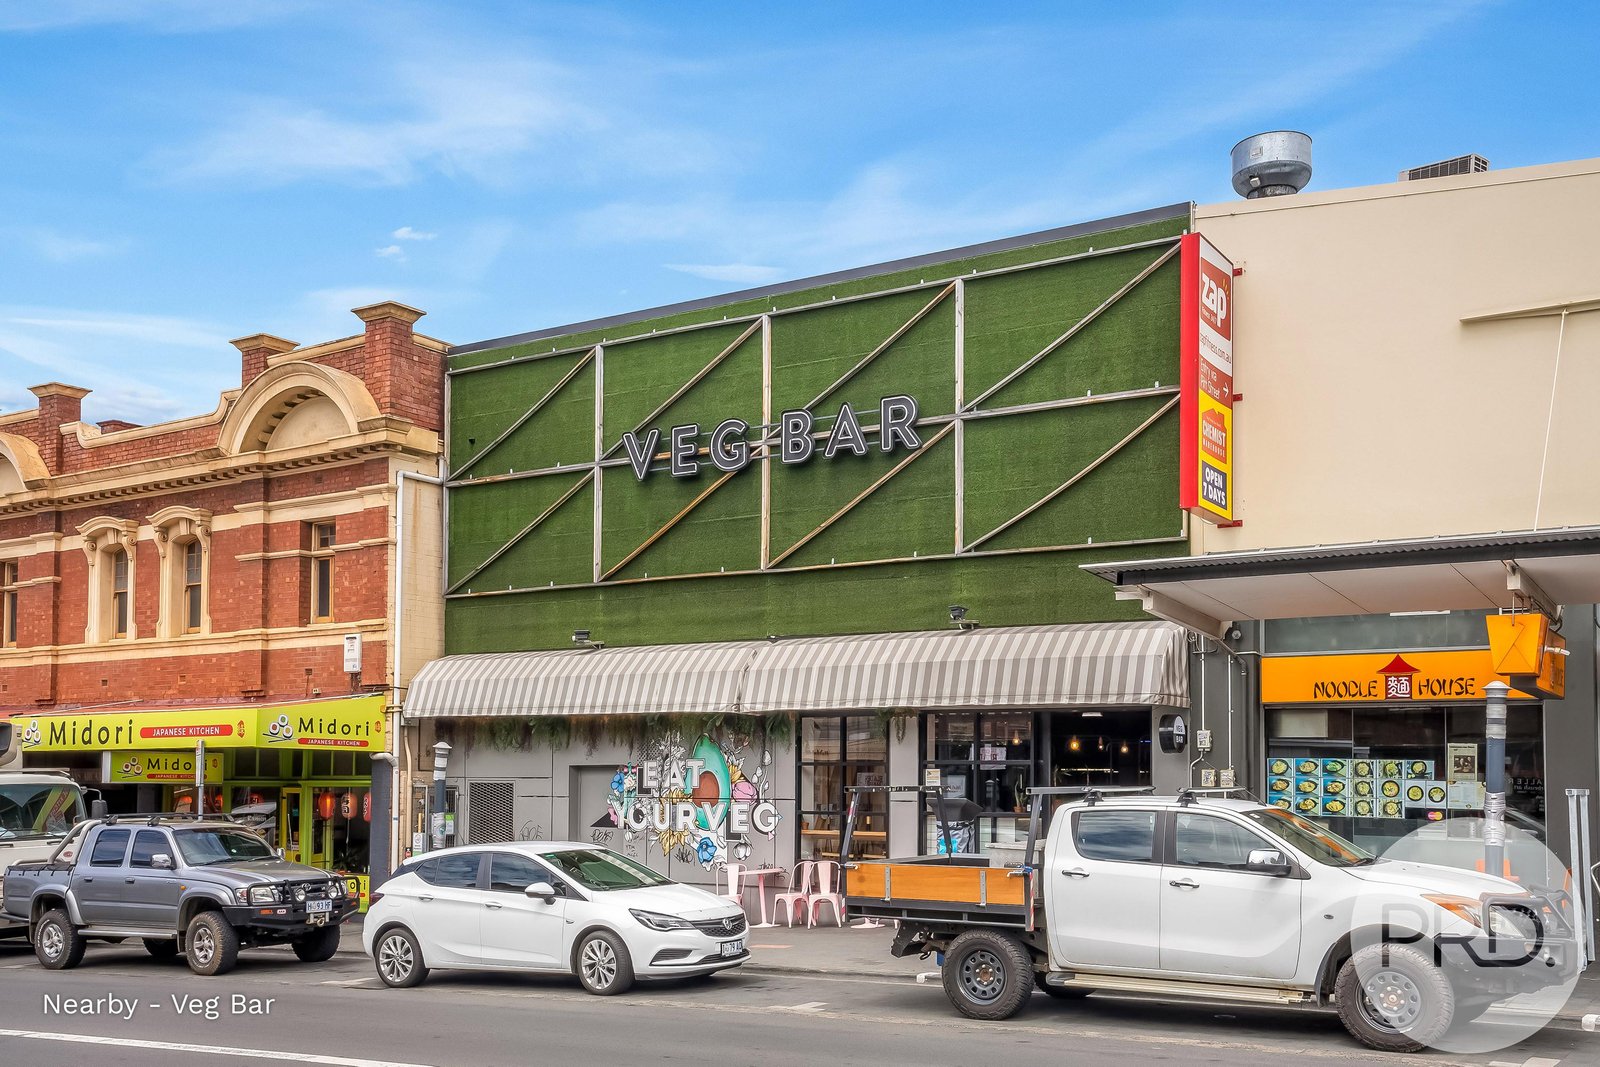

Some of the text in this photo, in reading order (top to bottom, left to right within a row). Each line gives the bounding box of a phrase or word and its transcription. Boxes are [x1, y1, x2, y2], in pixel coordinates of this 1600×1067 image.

[1202, 272, 1226, 328] zap
[622, 394, 923, 481] VEG BAR
[1203, 420, 1225, 447] CHEMIST
[1205, 467, 1223, 489] OPEN
[1203, 481, 1226, 506] 7 DAYS
[1313, 677, 1475, 698] NOODLE HOUSE
[49, 719, 220, 746] Midori JAPANESE KITCHEN
[298, 717, 369, 737] Midori
[146, 757, 208, 771] Midoi
[642, 758, 705, 789] EAT
[611, 801, 780, 834] YOUR VEG
